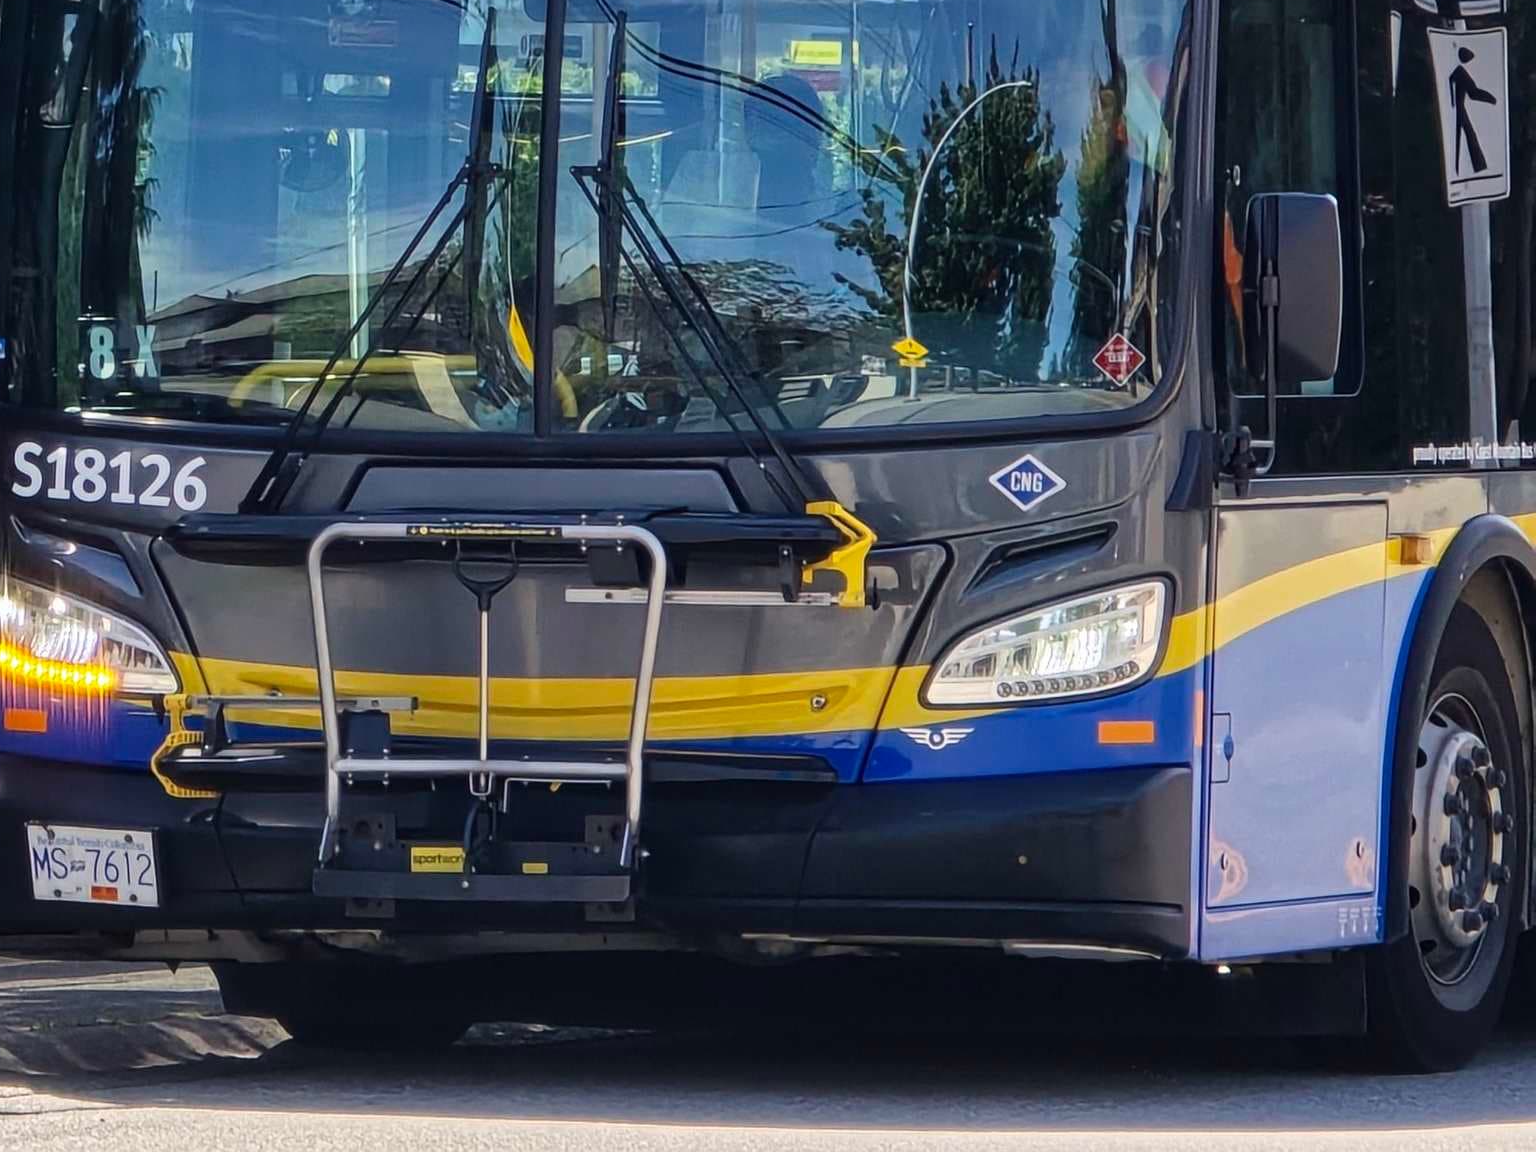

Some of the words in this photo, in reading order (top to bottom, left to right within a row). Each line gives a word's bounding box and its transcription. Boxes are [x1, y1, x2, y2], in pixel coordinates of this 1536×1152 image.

[11, 441, 208, 512] S18126
[1010, 471, 1043, 493] CNG
[32, 847, 68, 880] MS
[84, 848, 154, 887] 7612
